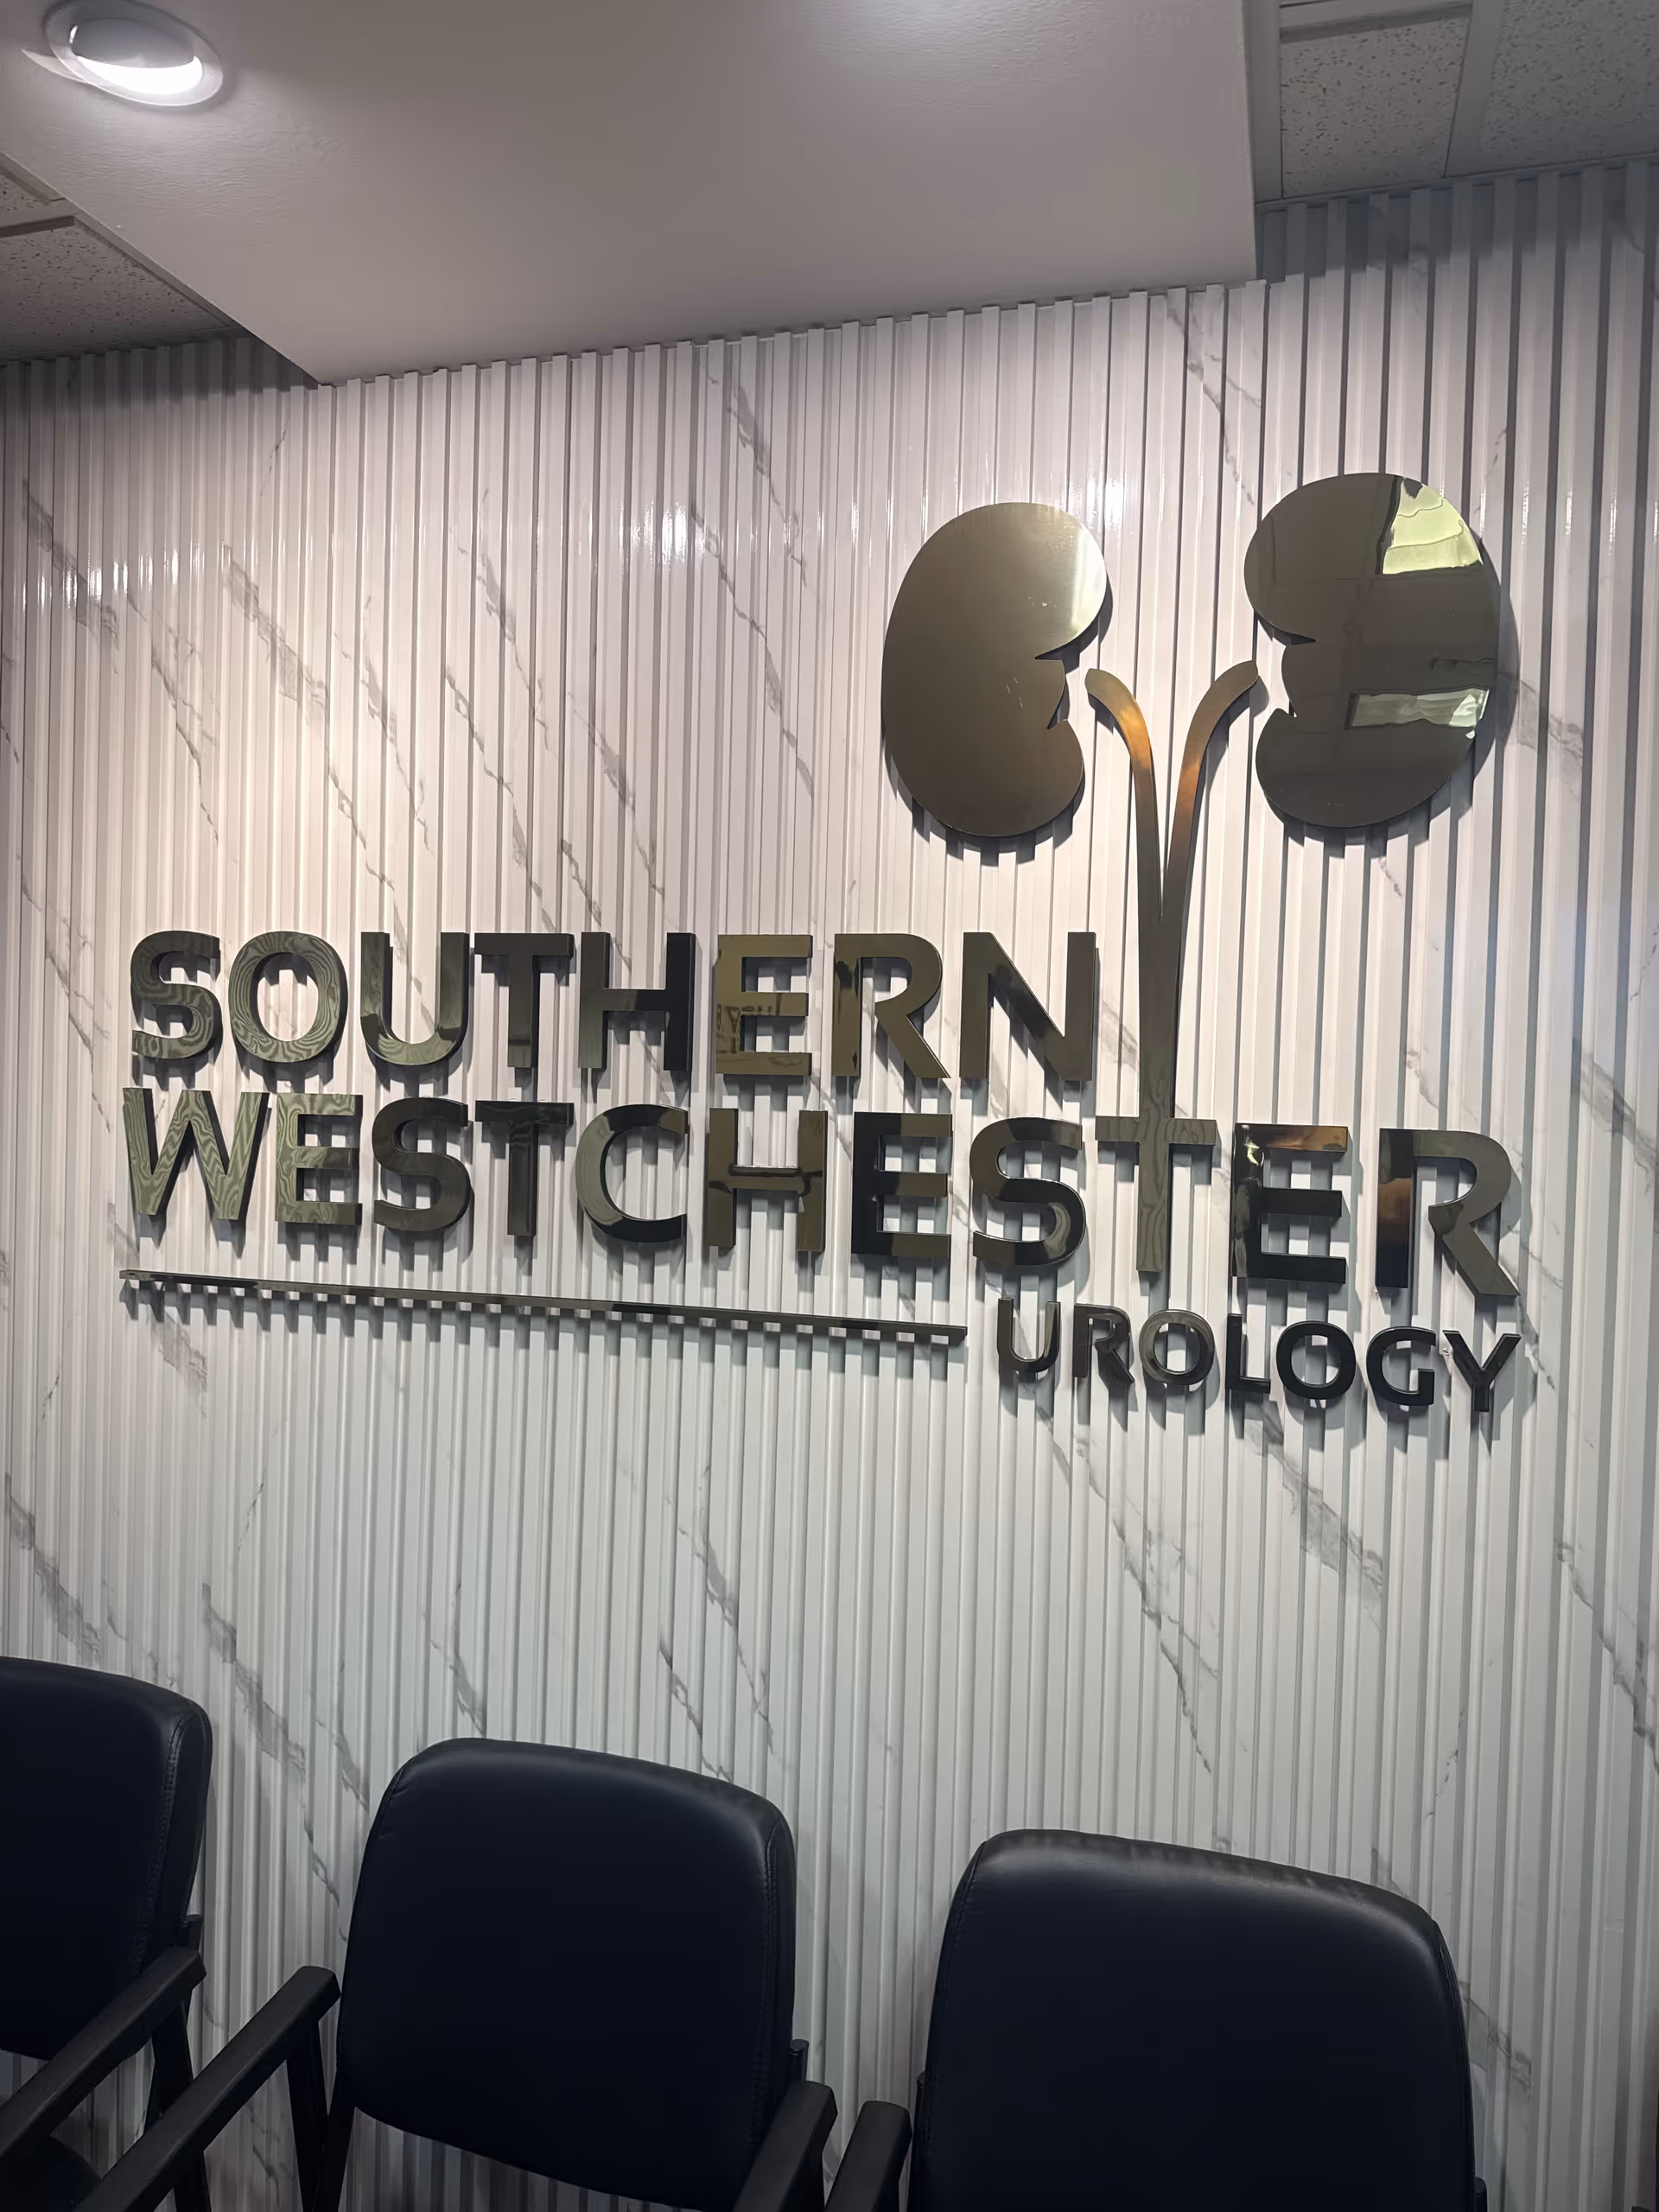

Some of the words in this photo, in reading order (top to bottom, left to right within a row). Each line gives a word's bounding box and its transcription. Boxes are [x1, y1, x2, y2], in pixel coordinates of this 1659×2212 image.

[130, 930, 1096, 1081] SOUTHERN
[123, 1087, 1521, 1296] WESTCHESTER
[996, 1298, 1522, 1412] UROLOGY
